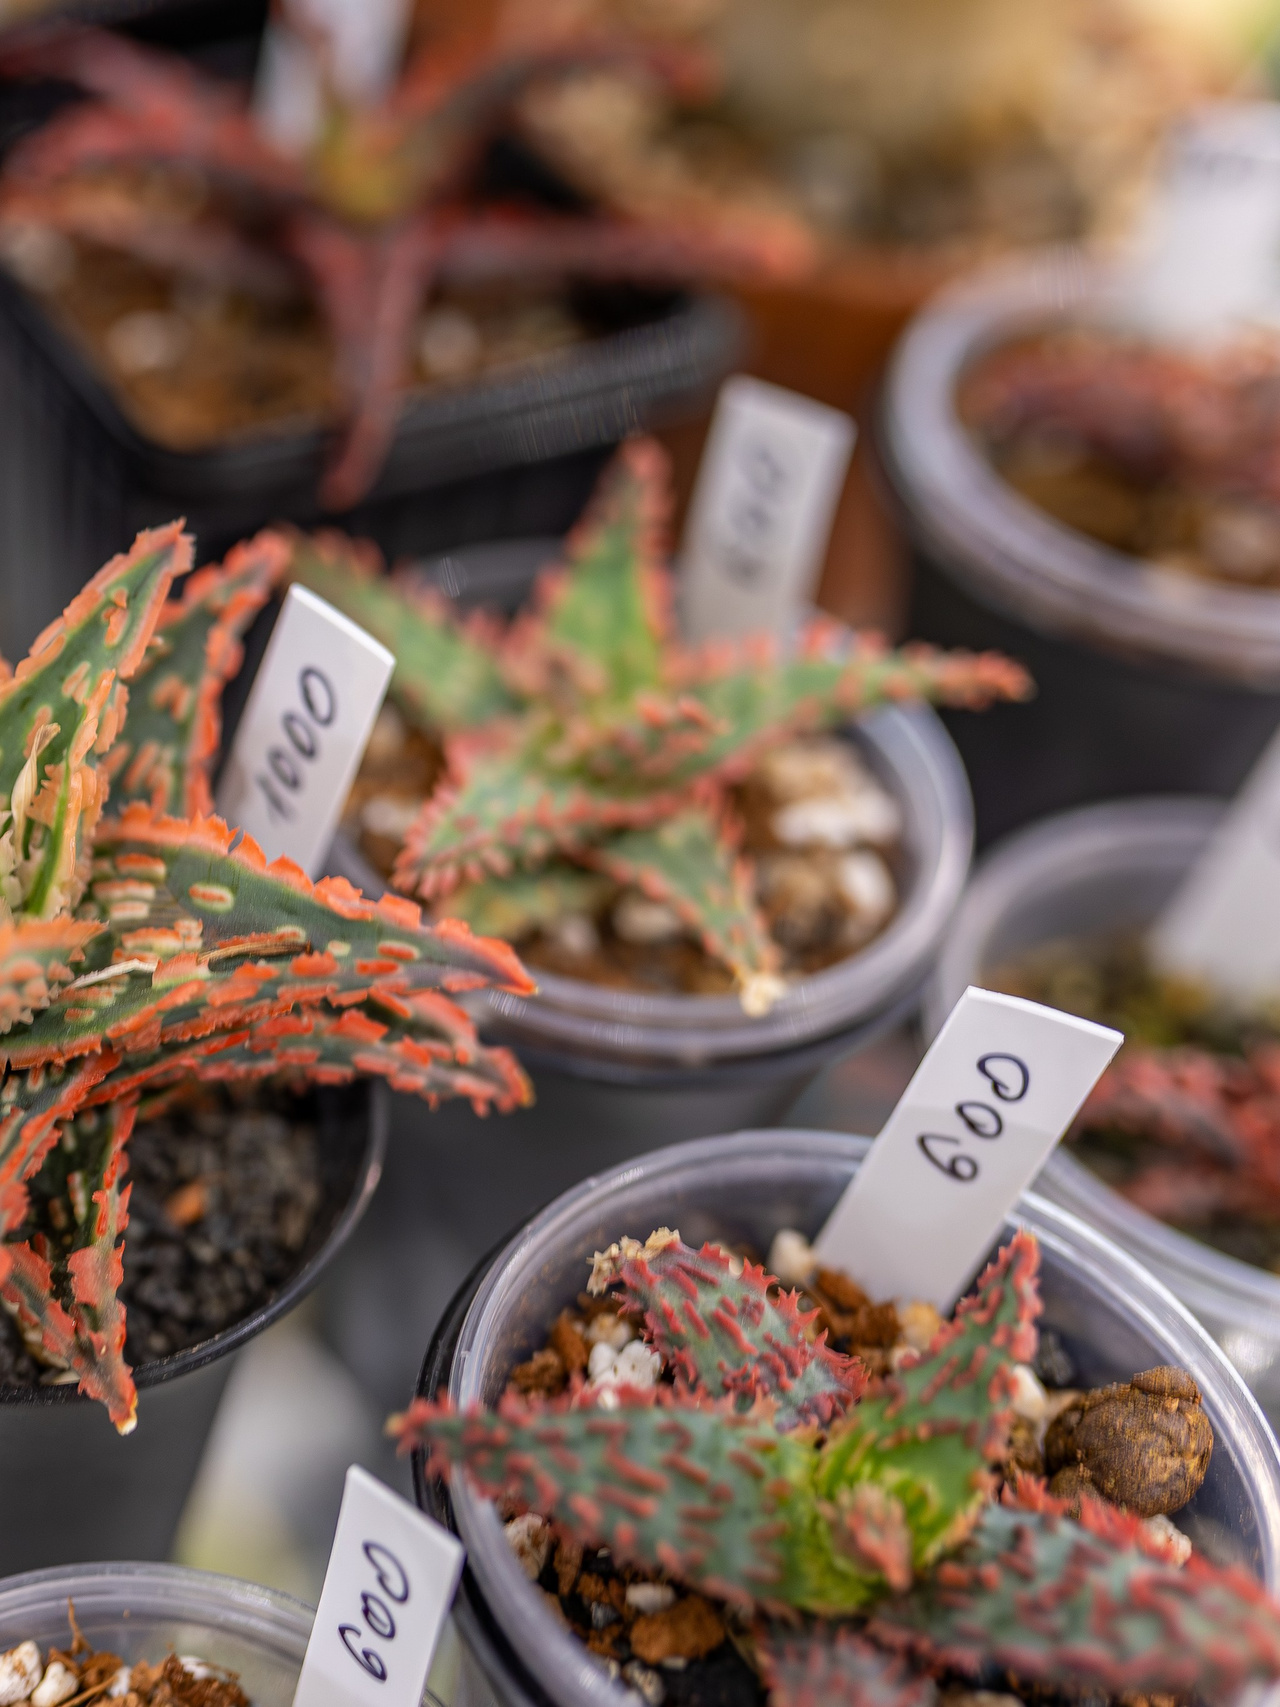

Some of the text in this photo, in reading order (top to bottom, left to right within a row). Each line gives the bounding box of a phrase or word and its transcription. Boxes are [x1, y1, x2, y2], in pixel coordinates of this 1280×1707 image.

[255, 664, 338, 823] 1000
[915, 1051, 1031, 1182] 600
[337, 1539, 410, 1684] 600
